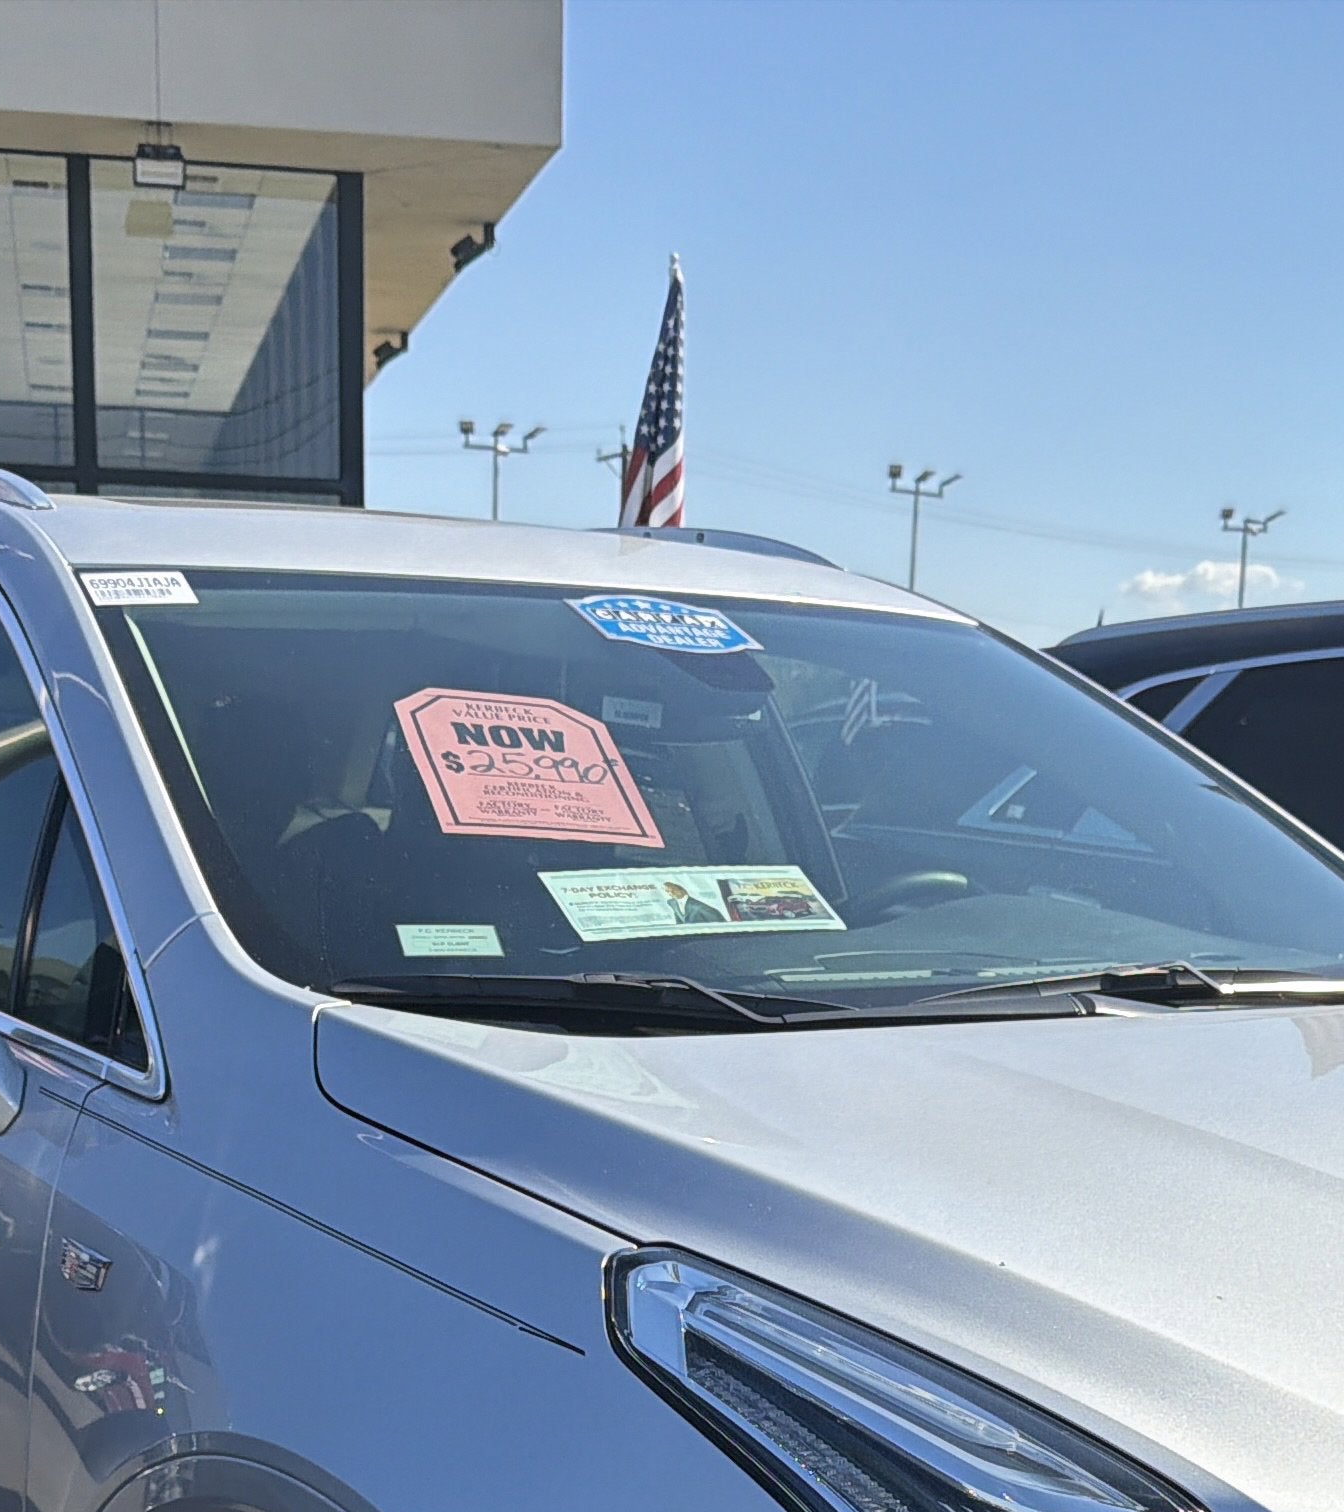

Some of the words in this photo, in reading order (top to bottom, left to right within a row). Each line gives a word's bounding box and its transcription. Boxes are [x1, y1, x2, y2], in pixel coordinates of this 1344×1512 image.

[617, 621, 732, 640] ADVANTAGE
[646, 633, 726, 649] DEALER
[452, 708, 503, 721] VALUE
[507, 713, 552, 725] PRICE
[464, 702, 534, 716] KERBECK
[450, 721, 566, 753] NOW
[596, 884, 657, 892] EXCHANGE
